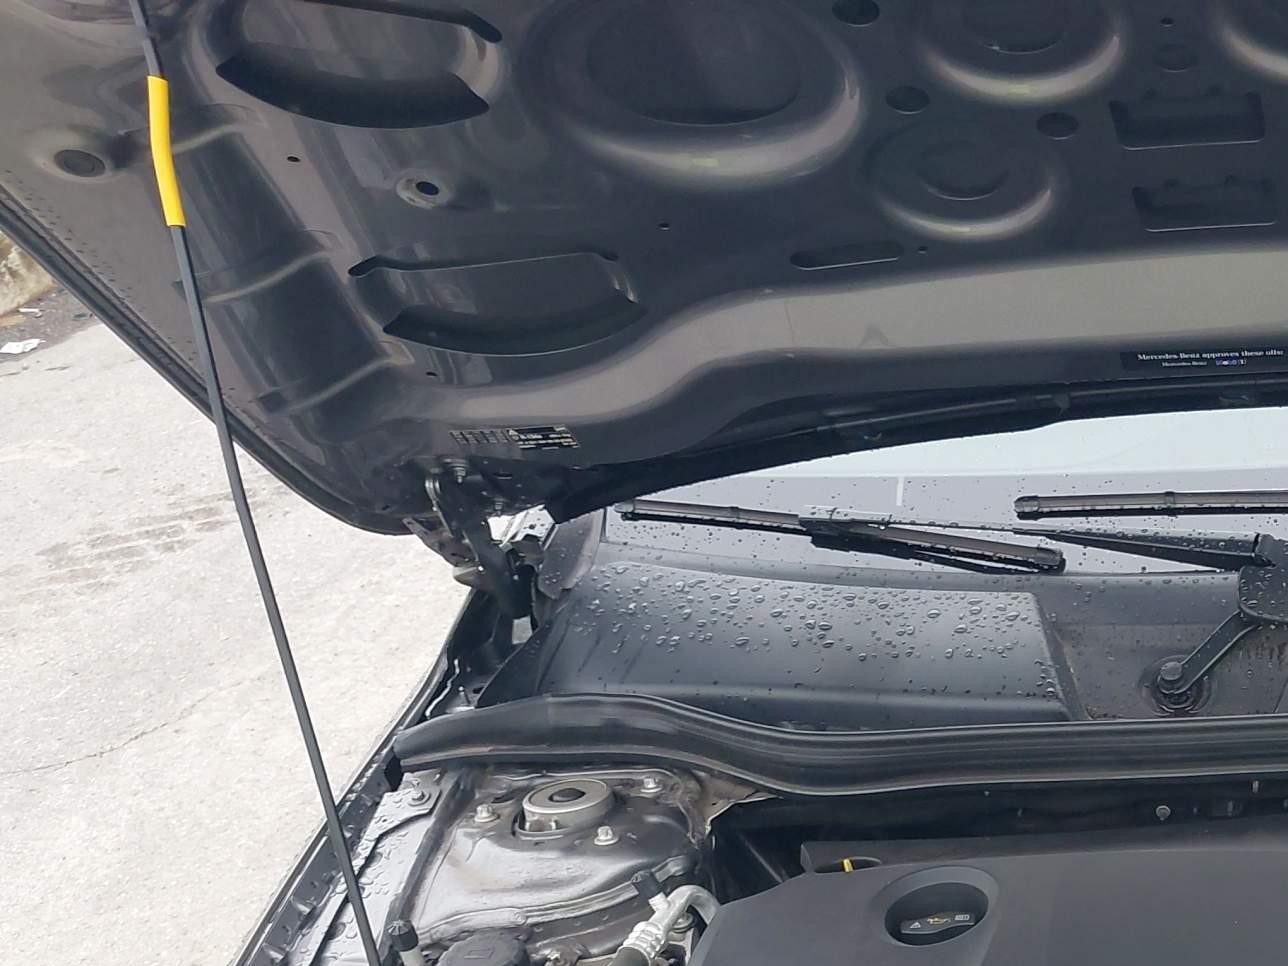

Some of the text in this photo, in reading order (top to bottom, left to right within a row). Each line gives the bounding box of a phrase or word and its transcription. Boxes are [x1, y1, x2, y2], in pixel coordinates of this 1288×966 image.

[1137, 352, 1200, 361] Mercedes-Benz
[1201, 351, 1239, 359] approves
[1241, 349, 1264, 357] these
